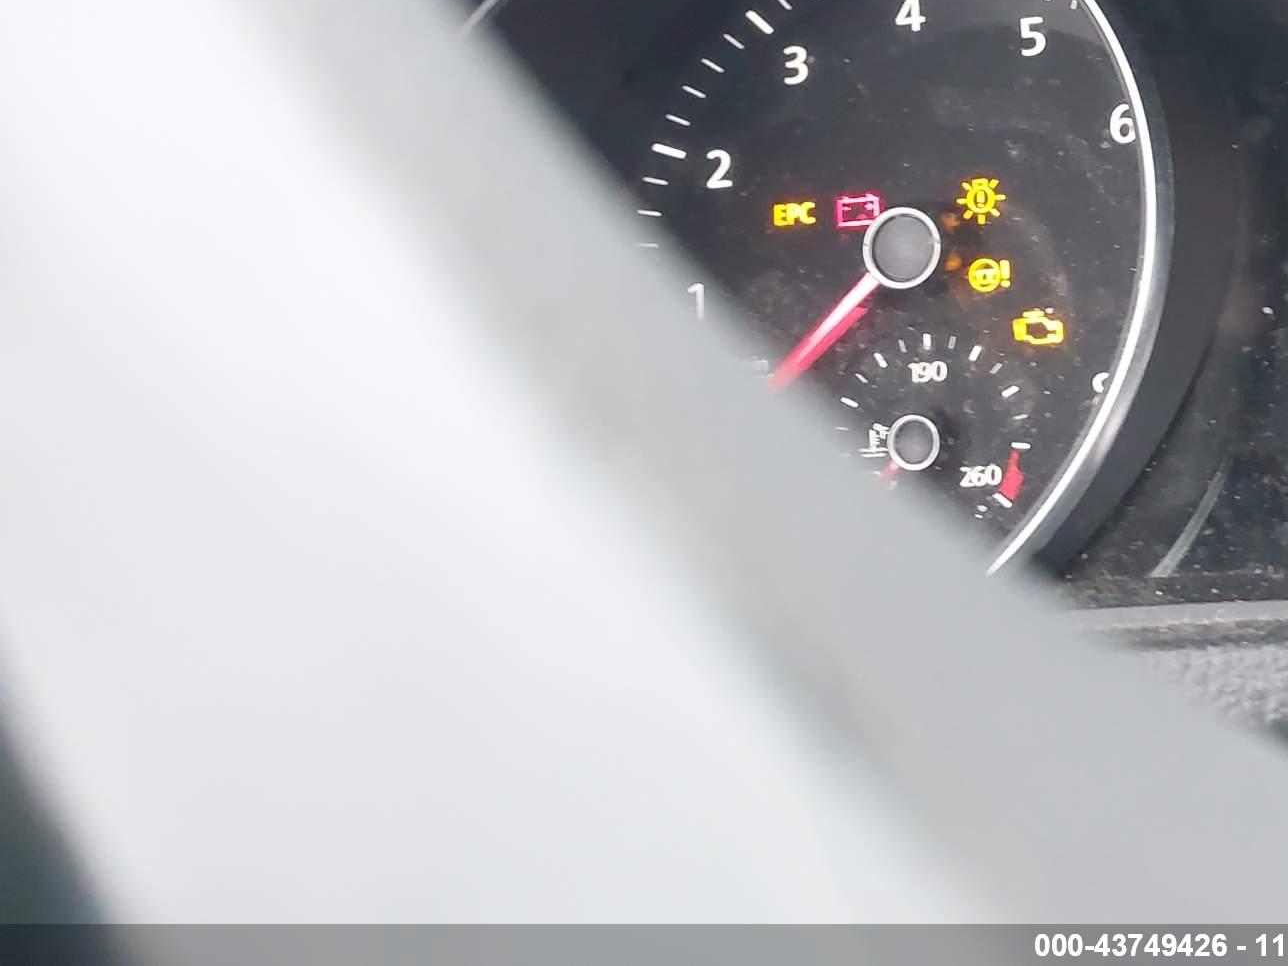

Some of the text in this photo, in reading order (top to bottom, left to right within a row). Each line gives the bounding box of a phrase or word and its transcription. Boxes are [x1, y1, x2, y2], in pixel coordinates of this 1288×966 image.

[1019, 16, 1046, 57] 5
[783, 45, 809, 85] 3
[1109, 103, 1135, 144] 6
[706, 149, 733, 189] 2
[773, 201, 817, 227] EPC
[687, 283, 705, 320] 1
[907, 360, 948, 384] 190
[958, 463, 1003, 488] 260
